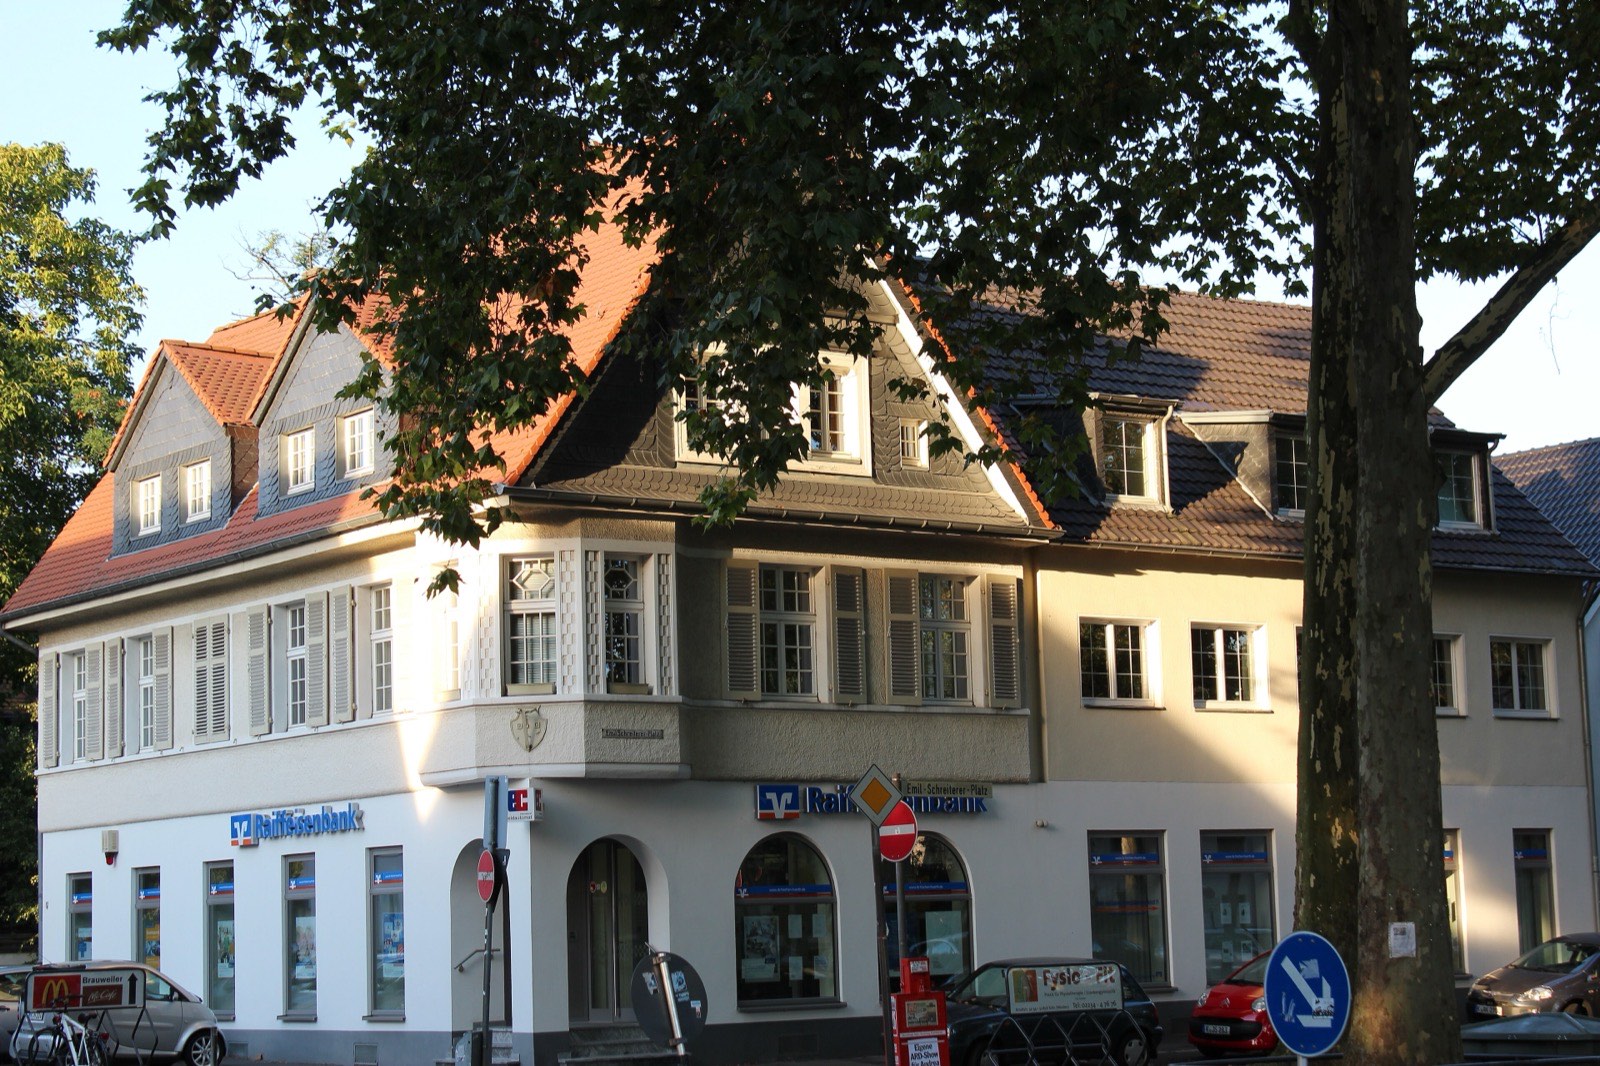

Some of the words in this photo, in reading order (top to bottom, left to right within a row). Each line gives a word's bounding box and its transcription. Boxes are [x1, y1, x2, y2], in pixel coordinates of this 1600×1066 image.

[255, 803, 362, 838] Raiffeisenbank
[1043, 968, 1081, 991] Fysio
[910, 1050, 938, 1060] ARD-Show
[914, 1043, 932, 1052] Eigene
